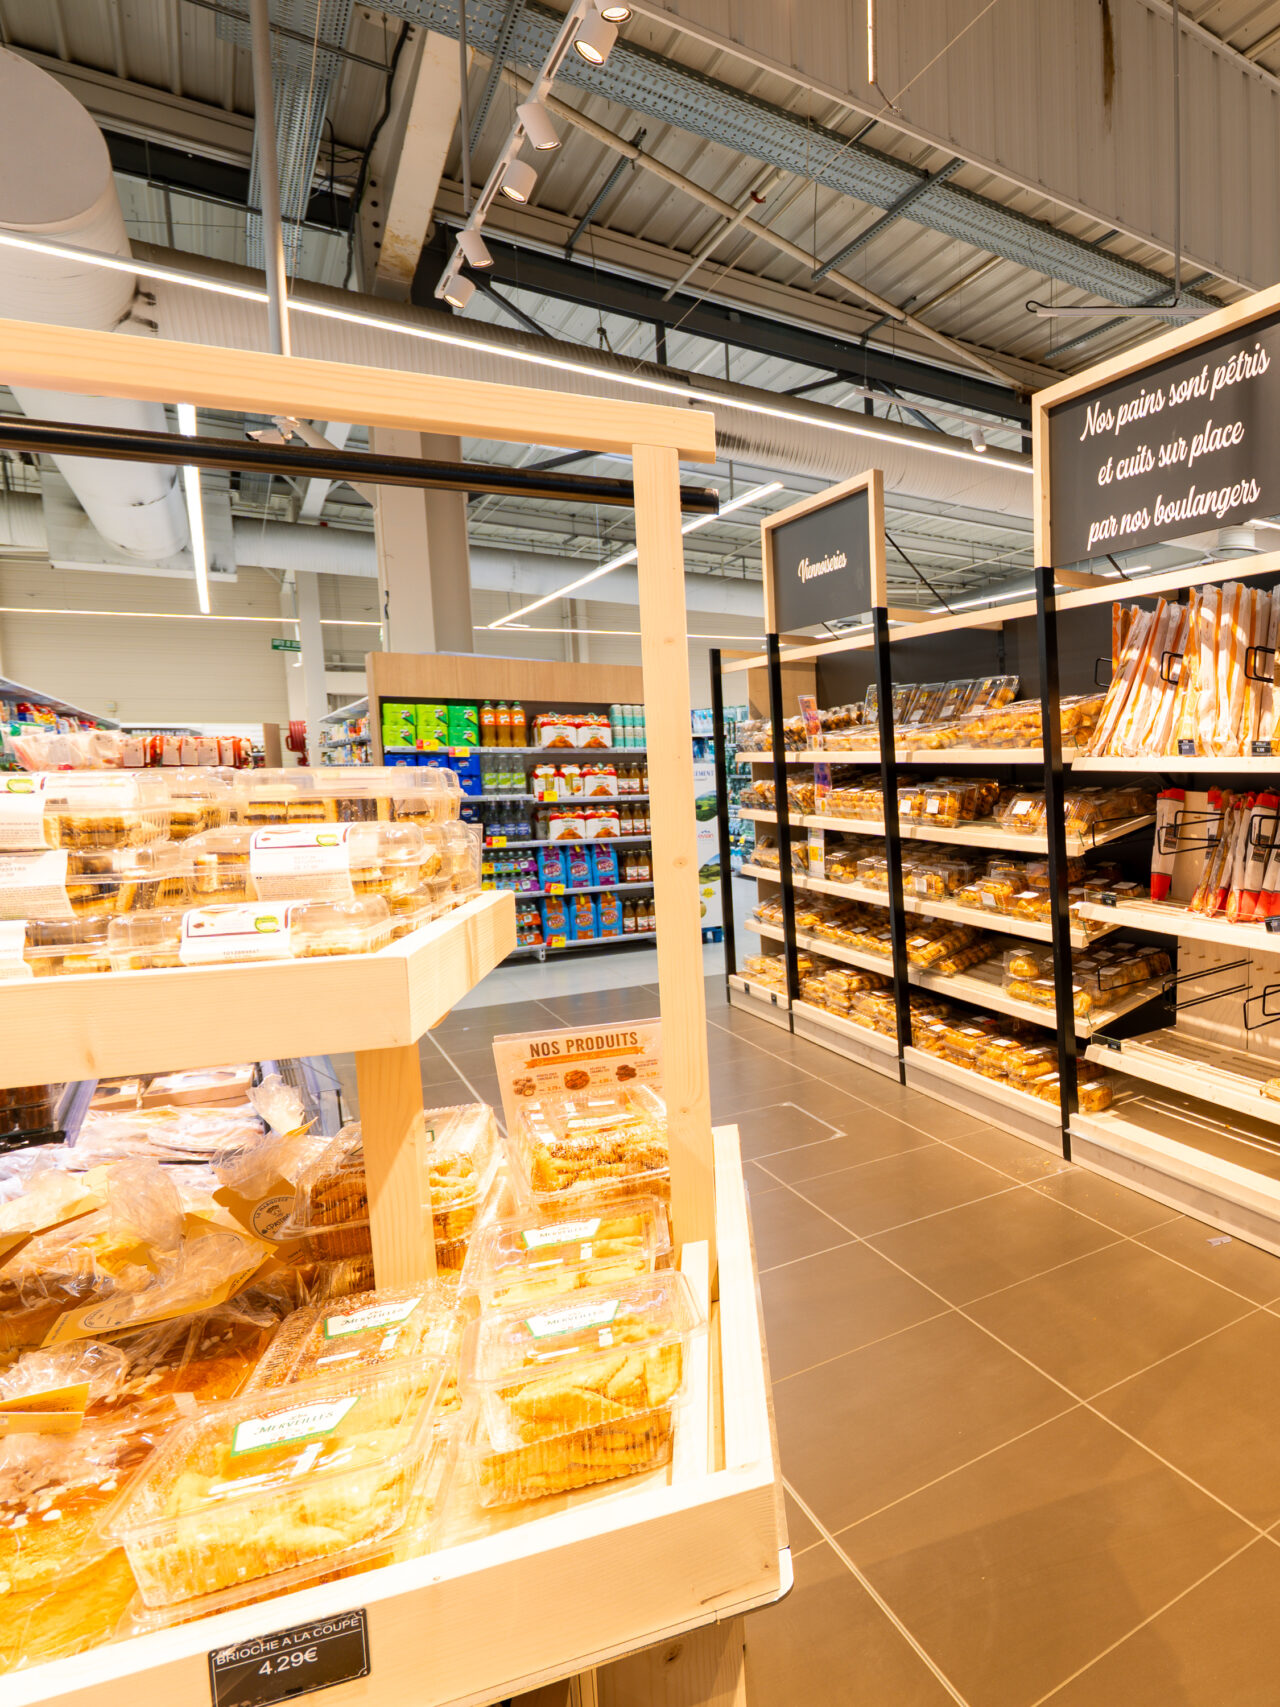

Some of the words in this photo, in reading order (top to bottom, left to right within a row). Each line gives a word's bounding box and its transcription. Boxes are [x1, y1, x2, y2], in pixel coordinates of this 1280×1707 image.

[1080, 401, 1115, 441] Nos
[1116, 390, 1165, 434] pains
[1169, 366, 1209, 406] sont
[1210, 343, 1271, 400] pétris
[1098, 460, 1114, 486] et
[1116, 446, 1155, 481] cuits
[1158, 437, 1187, 468] sur
[1188, 419, 1245, 467] place
[1088, 517, 1119, 550] par
[1120, 508, 1151, 535] nos
[1153, 478, 1261, 527] boulangers
[798, 550, 847, 583] Viennoiseries
[529, 1040, 560, 1058] NOS
[566, 1031, 639, 1053] PRODUITS
[216, 1640, 279, 1666] BRIOCHE
[281, 1637, 291, 1647] A
[294, 1632, 311, 1643] LA
[258, 1646, 319, 1676] 4.29€
